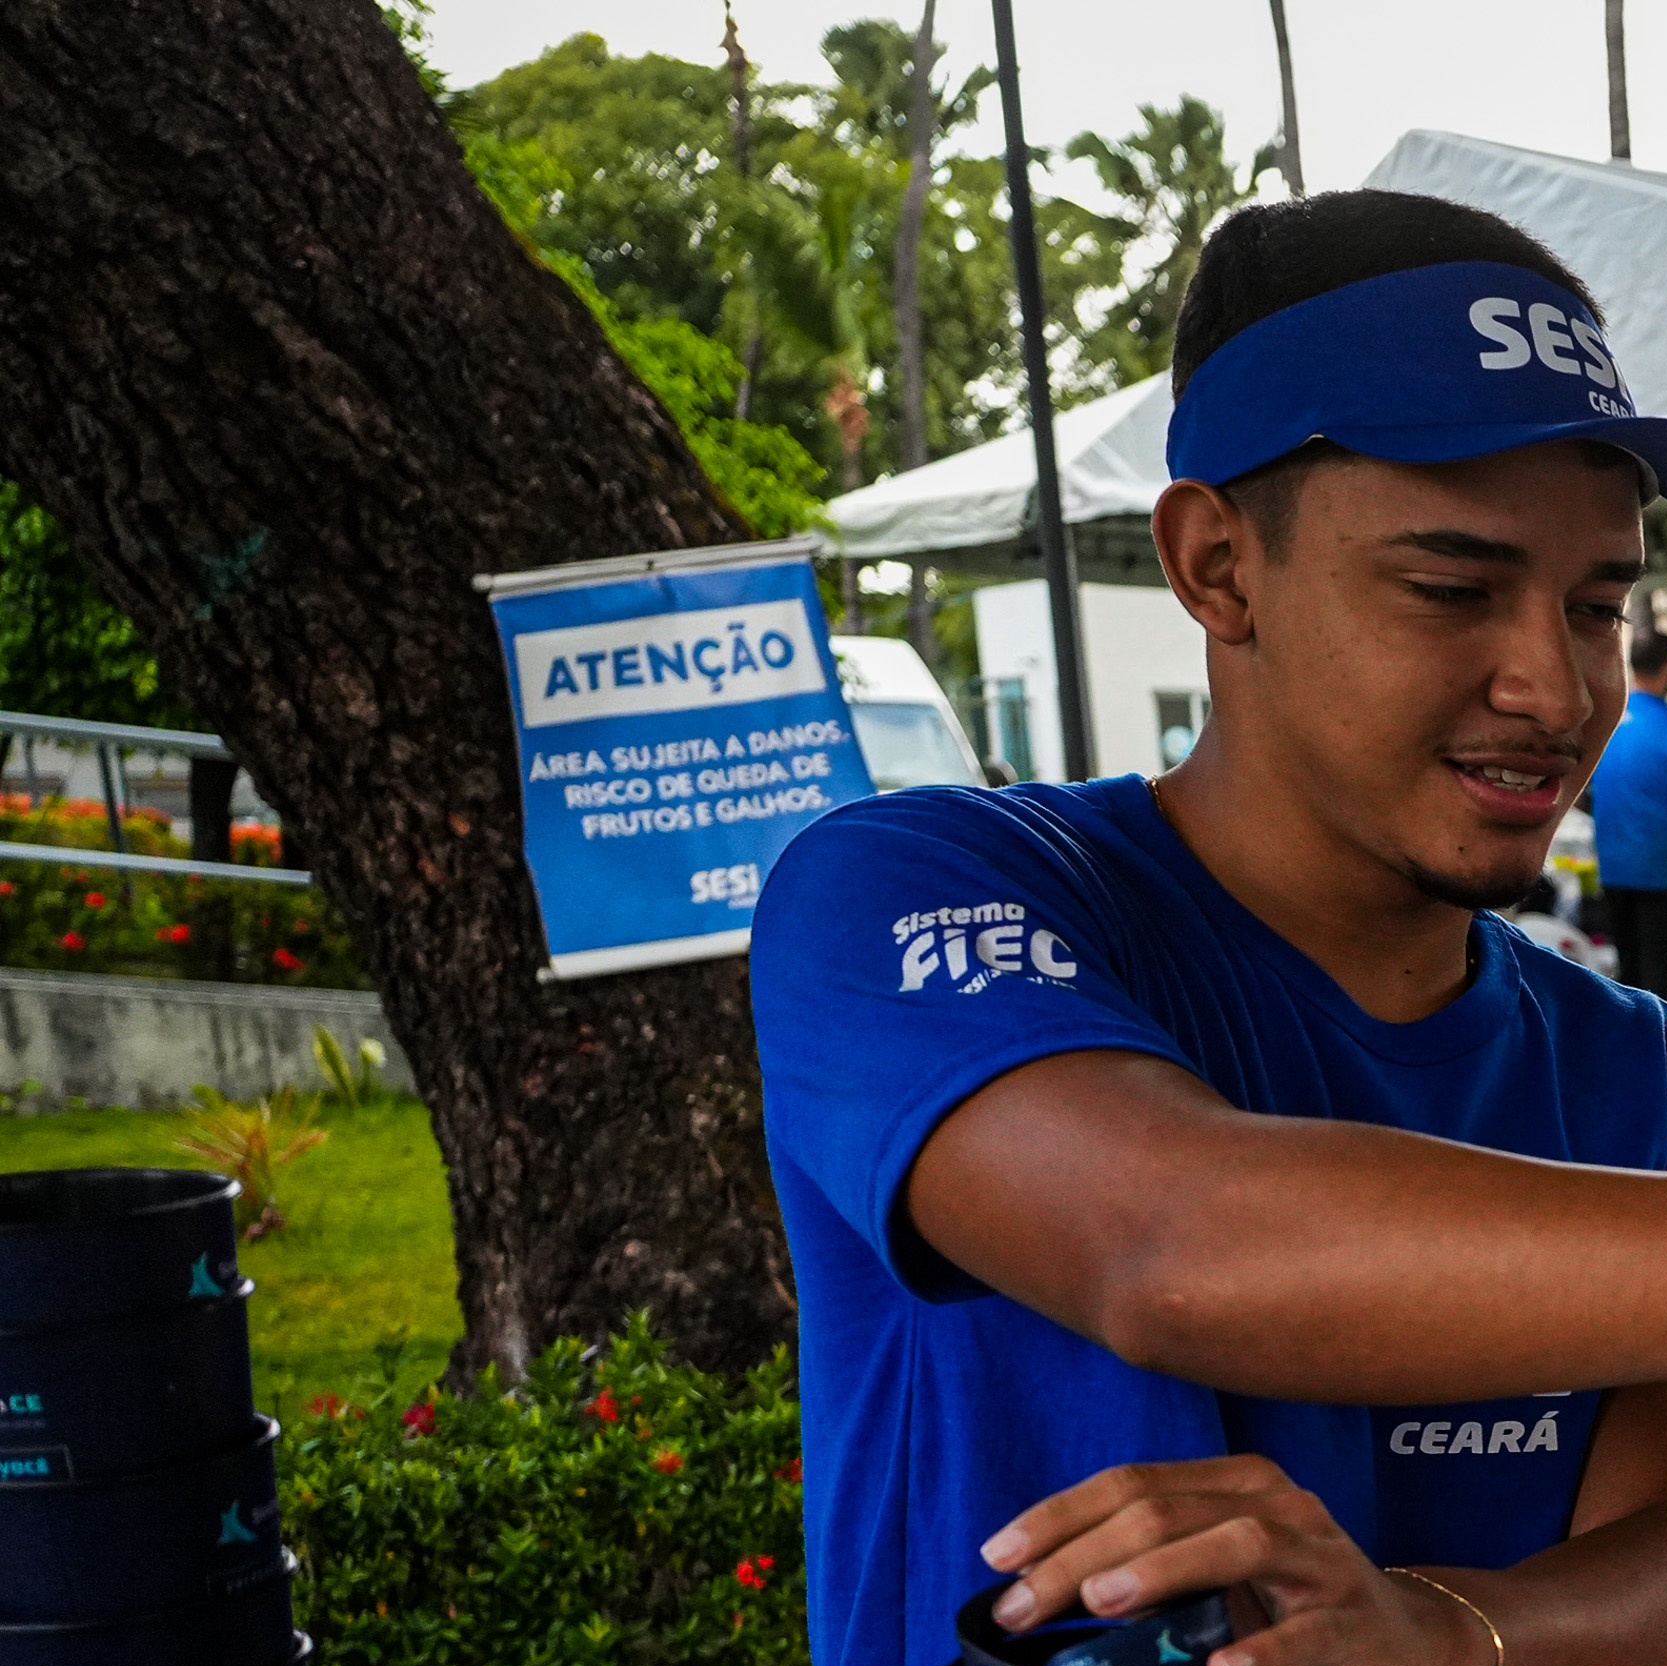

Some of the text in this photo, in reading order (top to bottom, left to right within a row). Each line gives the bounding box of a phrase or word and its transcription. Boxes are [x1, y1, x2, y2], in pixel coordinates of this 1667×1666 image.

[544, 620, 795, 698] ATENÇÃO
[528, 719, 849, 782] ÁREA SUJEITA A DANOS.
[563, 752, 832, 809] RISCO DE QUEDA DE
[581, 784, 832, 840] FRUTOS E GALHOS.
[690, 863, 761, 904] SESI
[1389, 1410, 1560, 1454] CEARÁ
